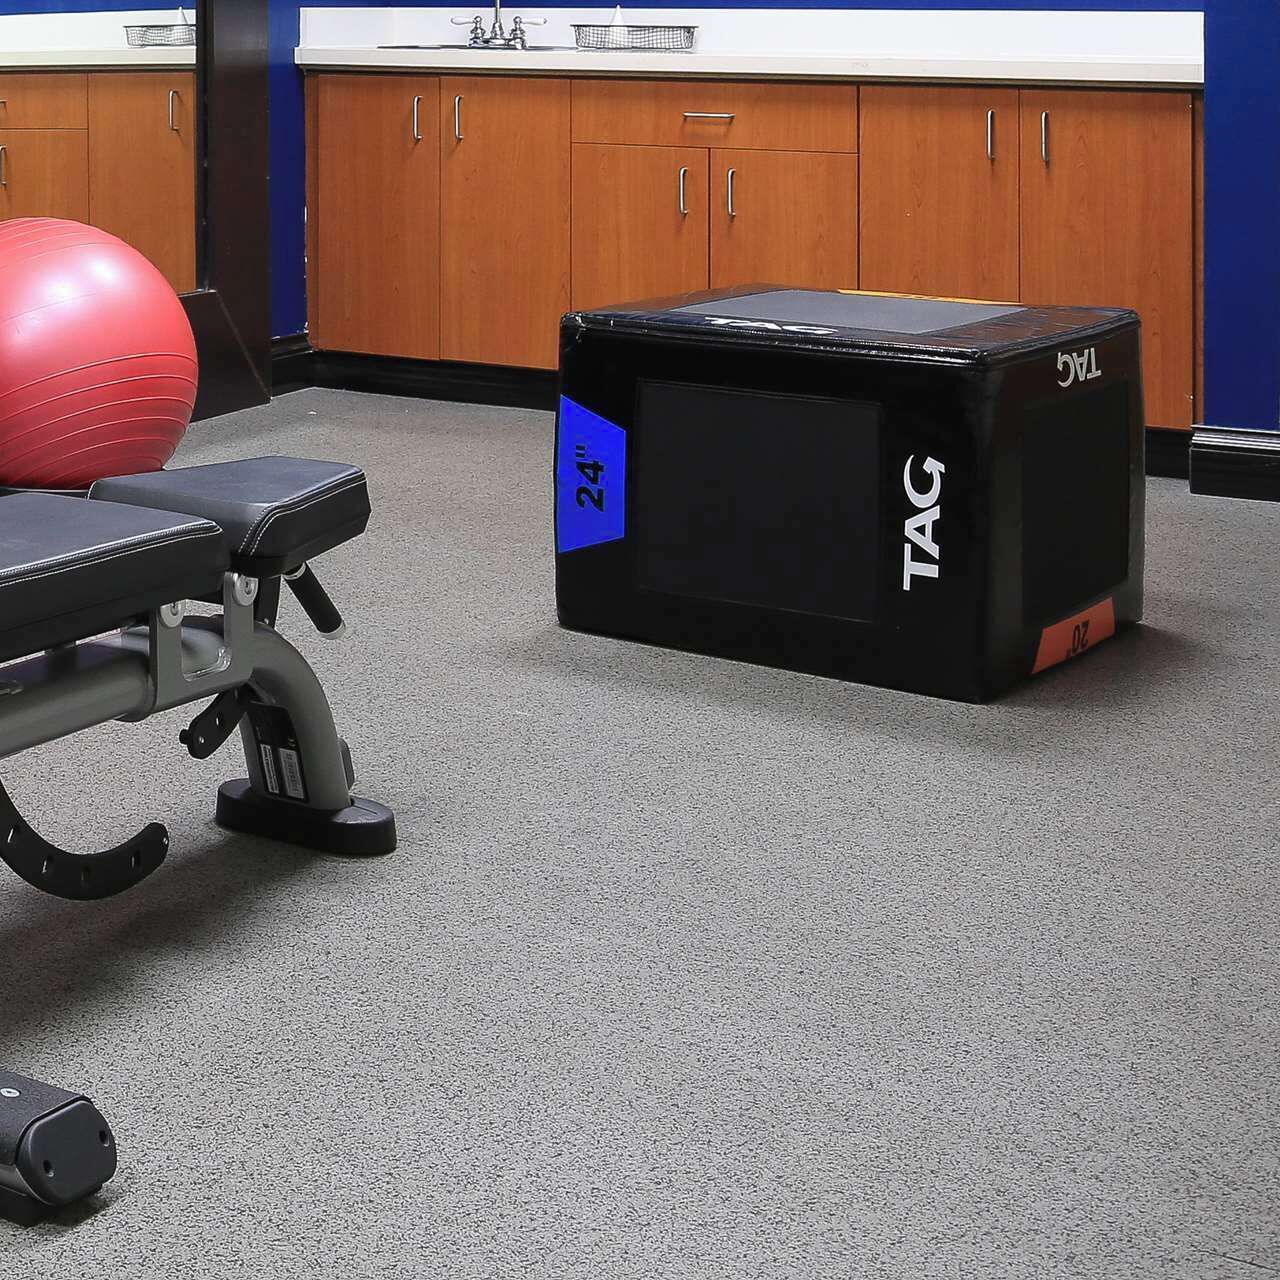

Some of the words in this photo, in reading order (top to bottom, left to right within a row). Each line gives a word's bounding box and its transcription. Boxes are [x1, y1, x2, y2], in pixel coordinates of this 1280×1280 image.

[704, 317, 839, 335] TAG
[1057, 347, 1102, 388] TAG
[575, 445, 605, 512] 24"
[903, 455, 946, 591] TAG
